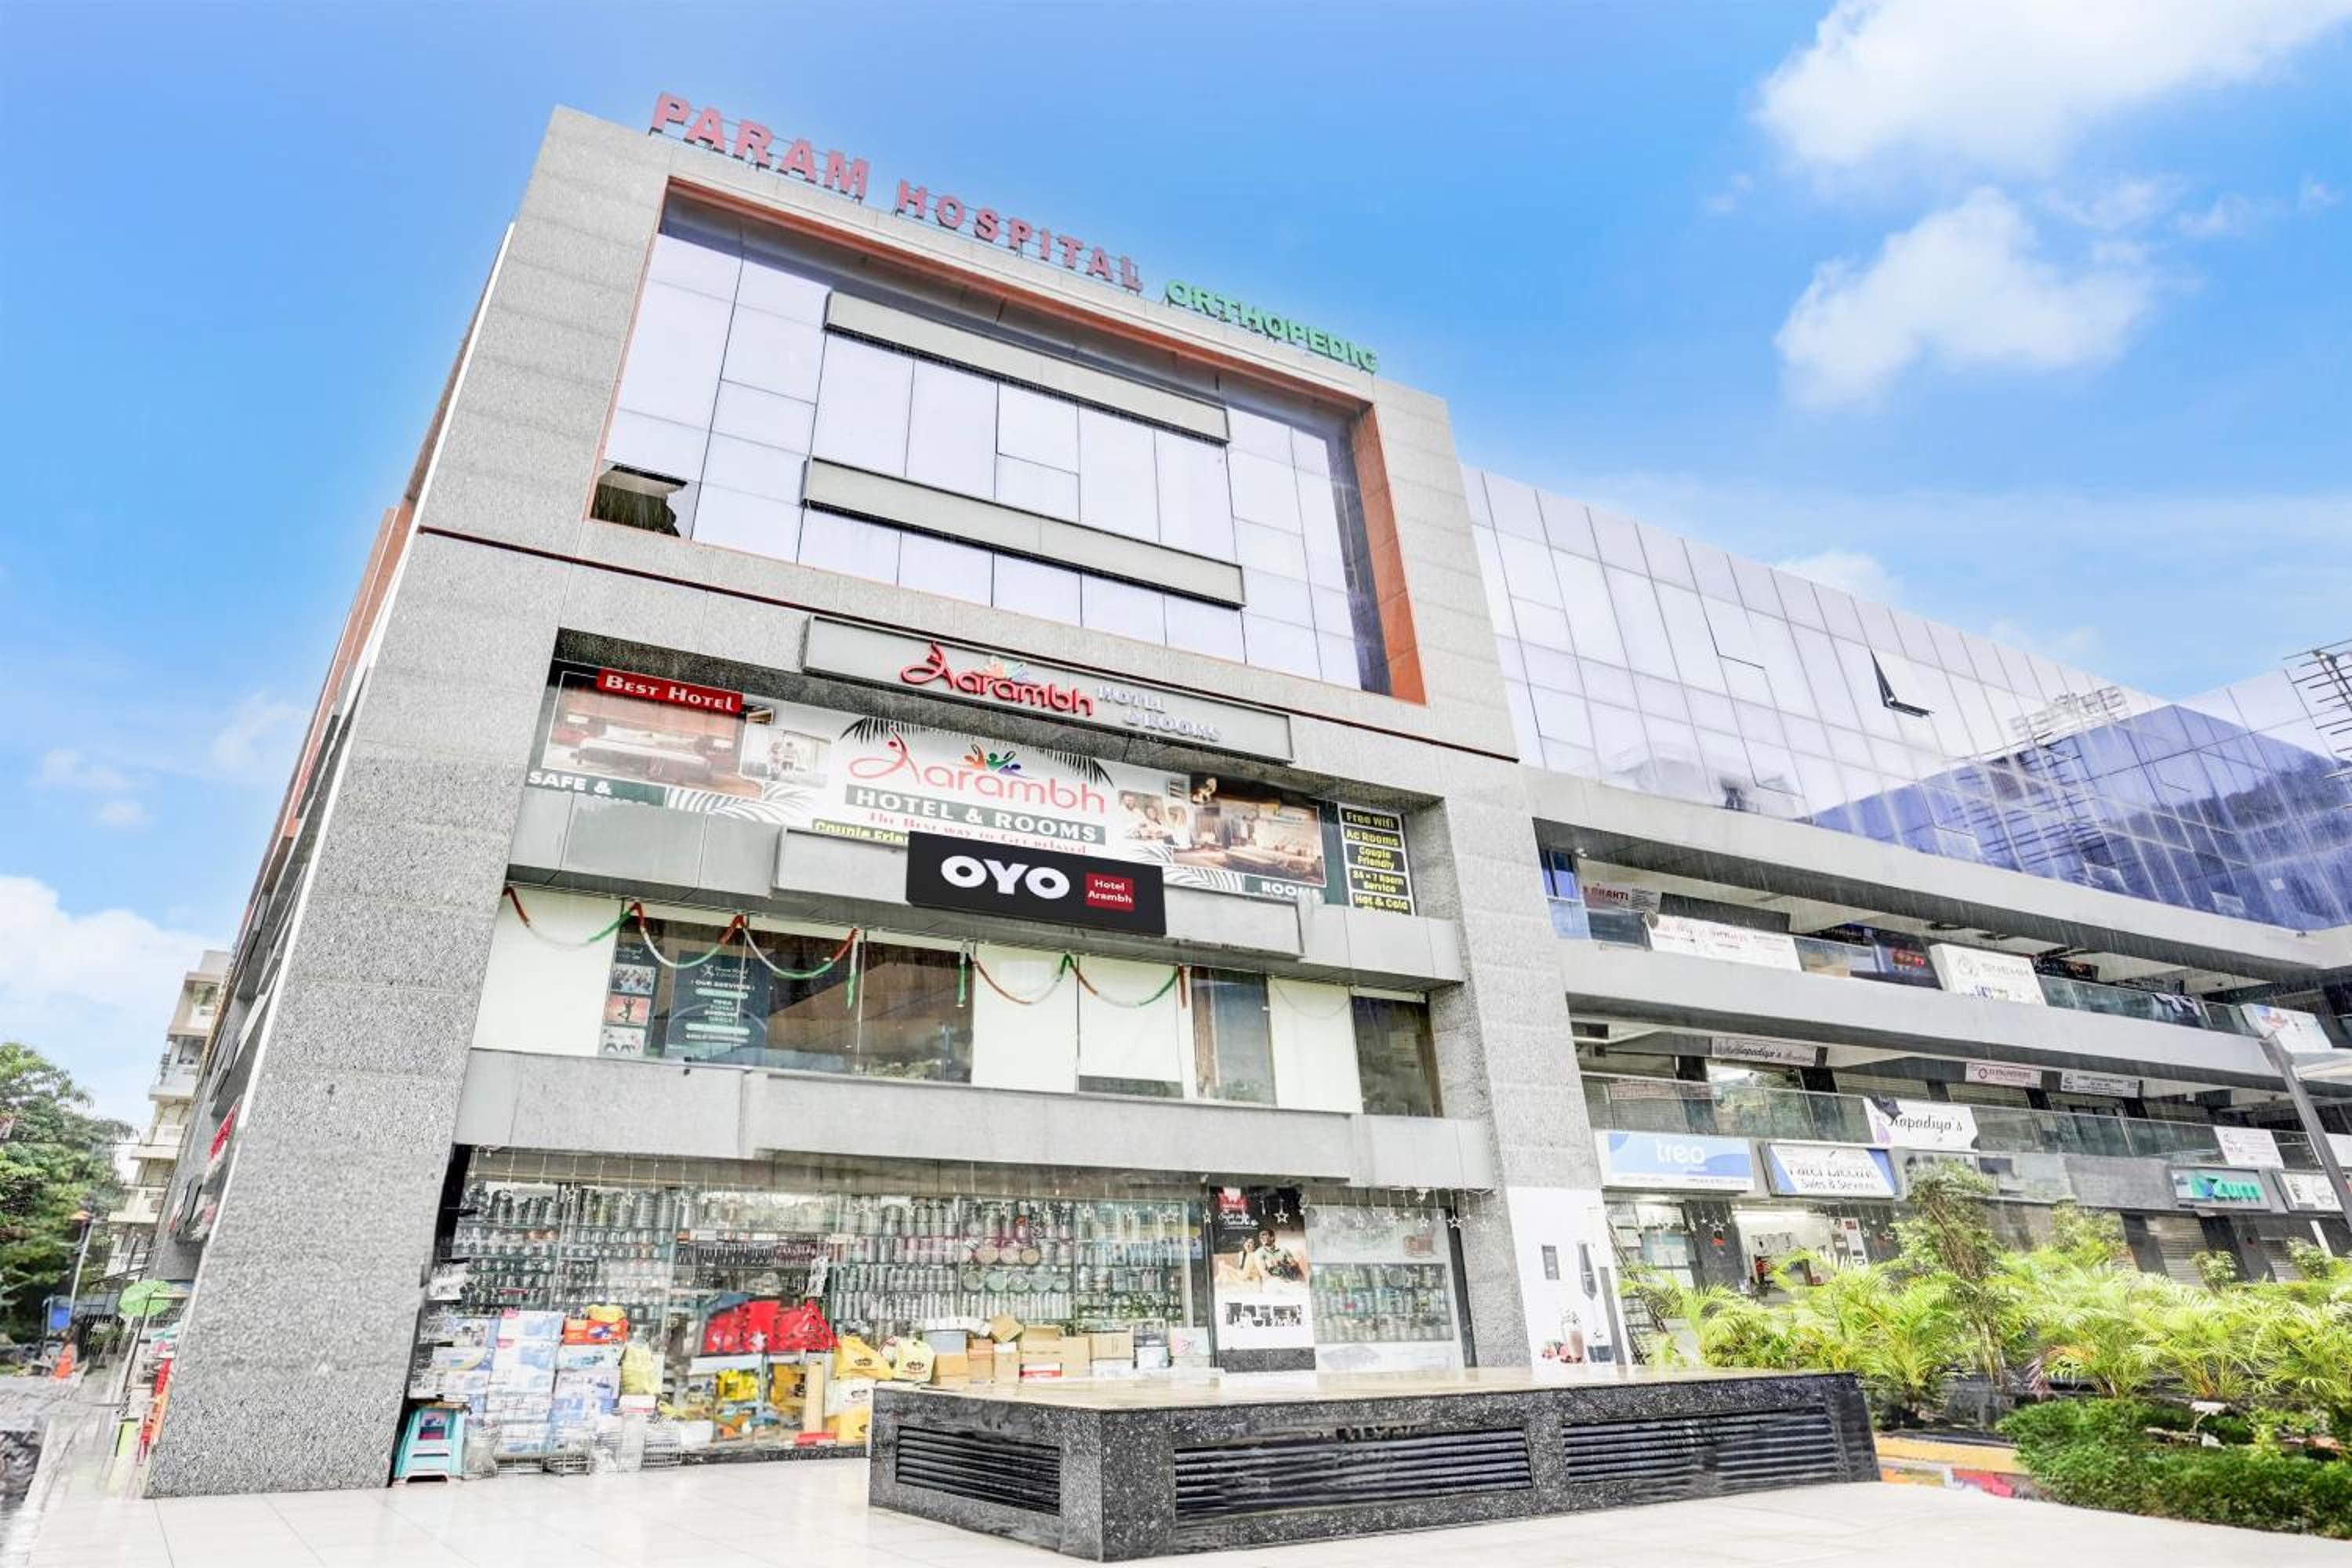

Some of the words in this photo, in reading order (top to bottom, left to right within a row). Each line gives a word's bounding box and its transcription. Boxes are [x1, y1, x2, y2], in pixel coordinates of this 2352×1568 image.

[650, 92, 870, 199] PARAM
[895, 180, 1144, 293] HOSPITAL
[1166, 280, 1379, 373] ORTHOPEDIC
[901, 641, 1093, 716] Aarambh
[1098, 686, 1165, 713] HOTEL
[528, 771, 587, 791] SAFE
[593, 780, 612, 795] &
[849, 728, 1104, 814] Aarambh
[855, 789, 954, 820] HOTEL
[965, 808, 982, 826] &
[995, 812, 1098, 842] ROOMS
[1346, 811, 1371, 825] Free
[1359, 847, 1392, 859] Couple
[941, 855, 1070, 899] OYO
[1094, 878, 1125, 891] Hotel
[1087, 890, 1133, 904] Arambh
[1656, 1139, 1706, 1165] treo
